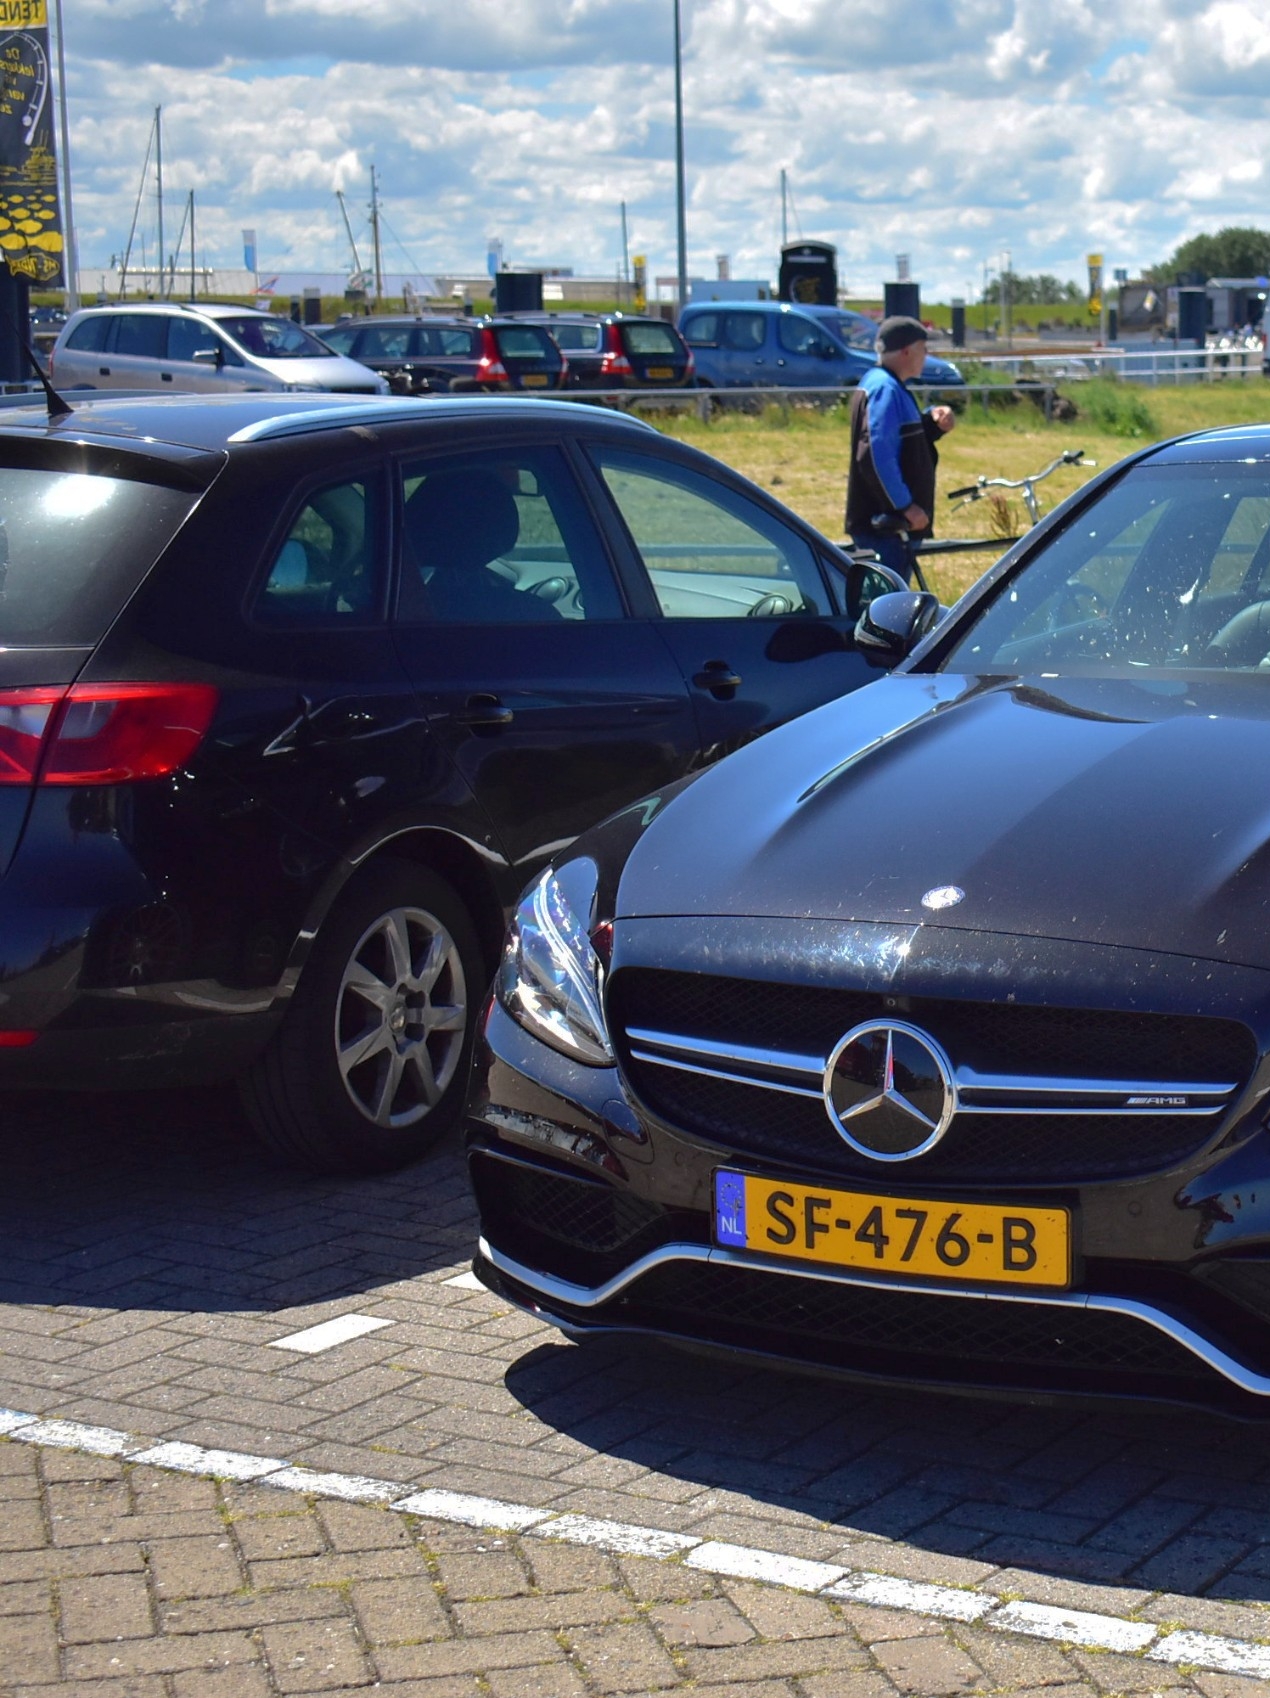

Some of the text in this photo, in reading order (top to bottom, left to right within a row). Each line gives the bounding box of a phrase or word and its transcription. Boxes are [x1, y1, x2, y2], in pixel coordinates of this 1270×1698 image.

[1144, 1096, 1186, 1105] AMG
[721, 1217, 742, 1236] NL
[766, 1190, 1037, 1272] SF-476-B
